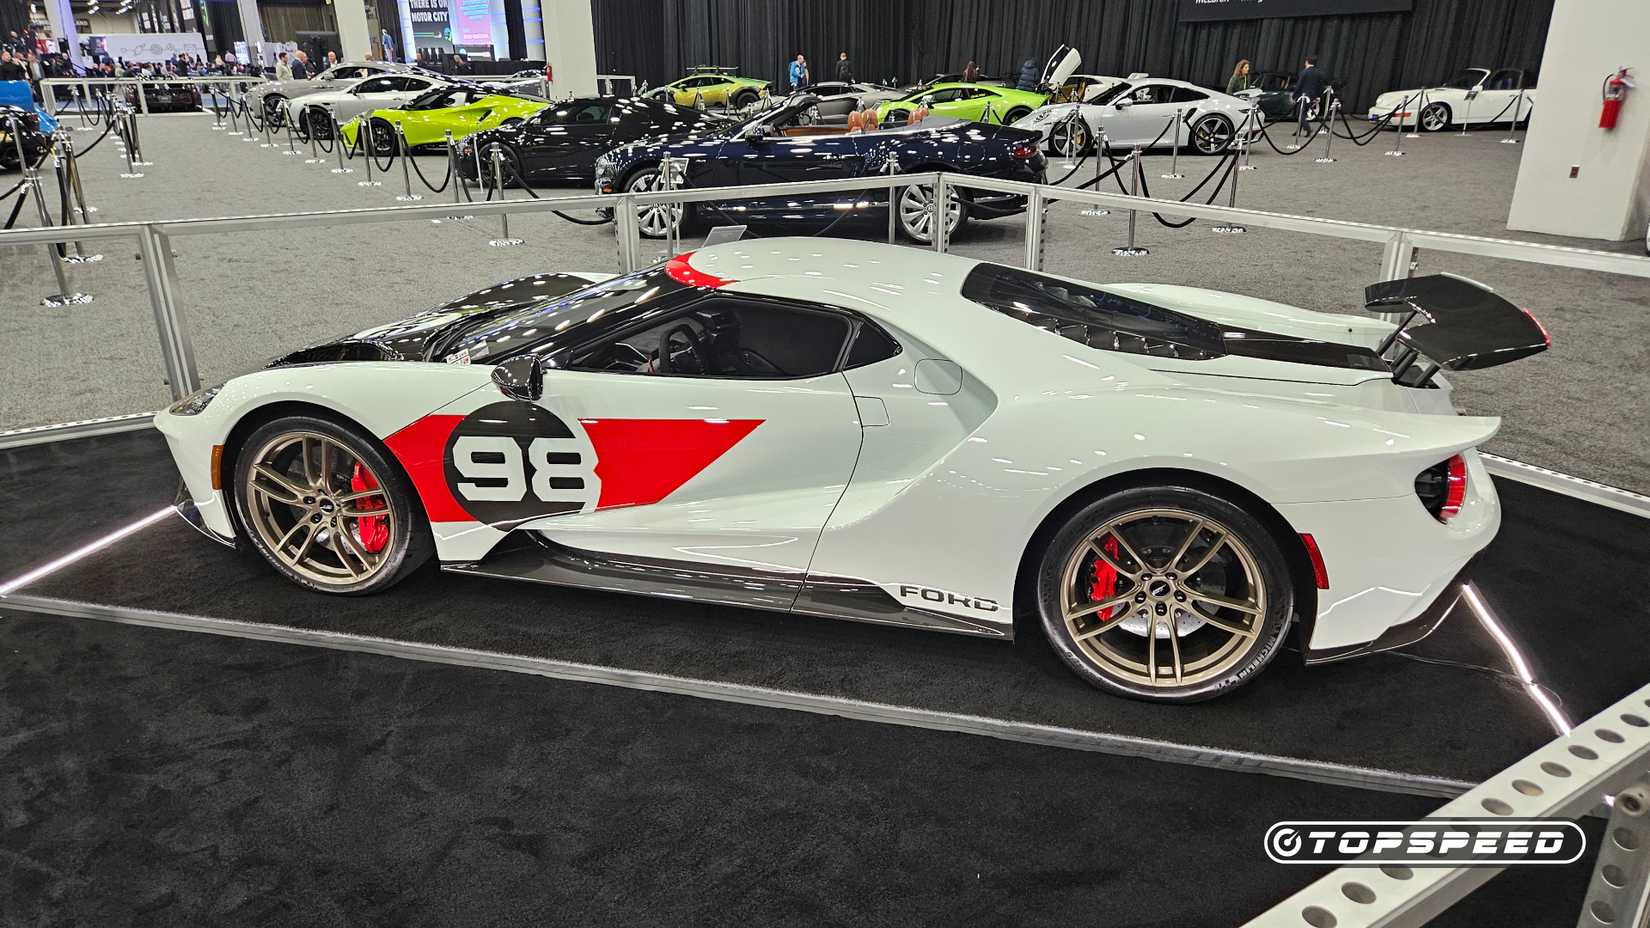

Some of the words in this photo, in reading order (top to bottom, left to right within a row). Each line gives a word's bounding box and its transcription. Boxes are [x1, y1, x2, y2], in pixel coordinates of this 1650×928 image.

[411, 12, 433, 22] MOTOR
[433, 11, 448, 22] CITY
[452, 436, 602, 502] 98
[900, 585, 999, 612] FORD
